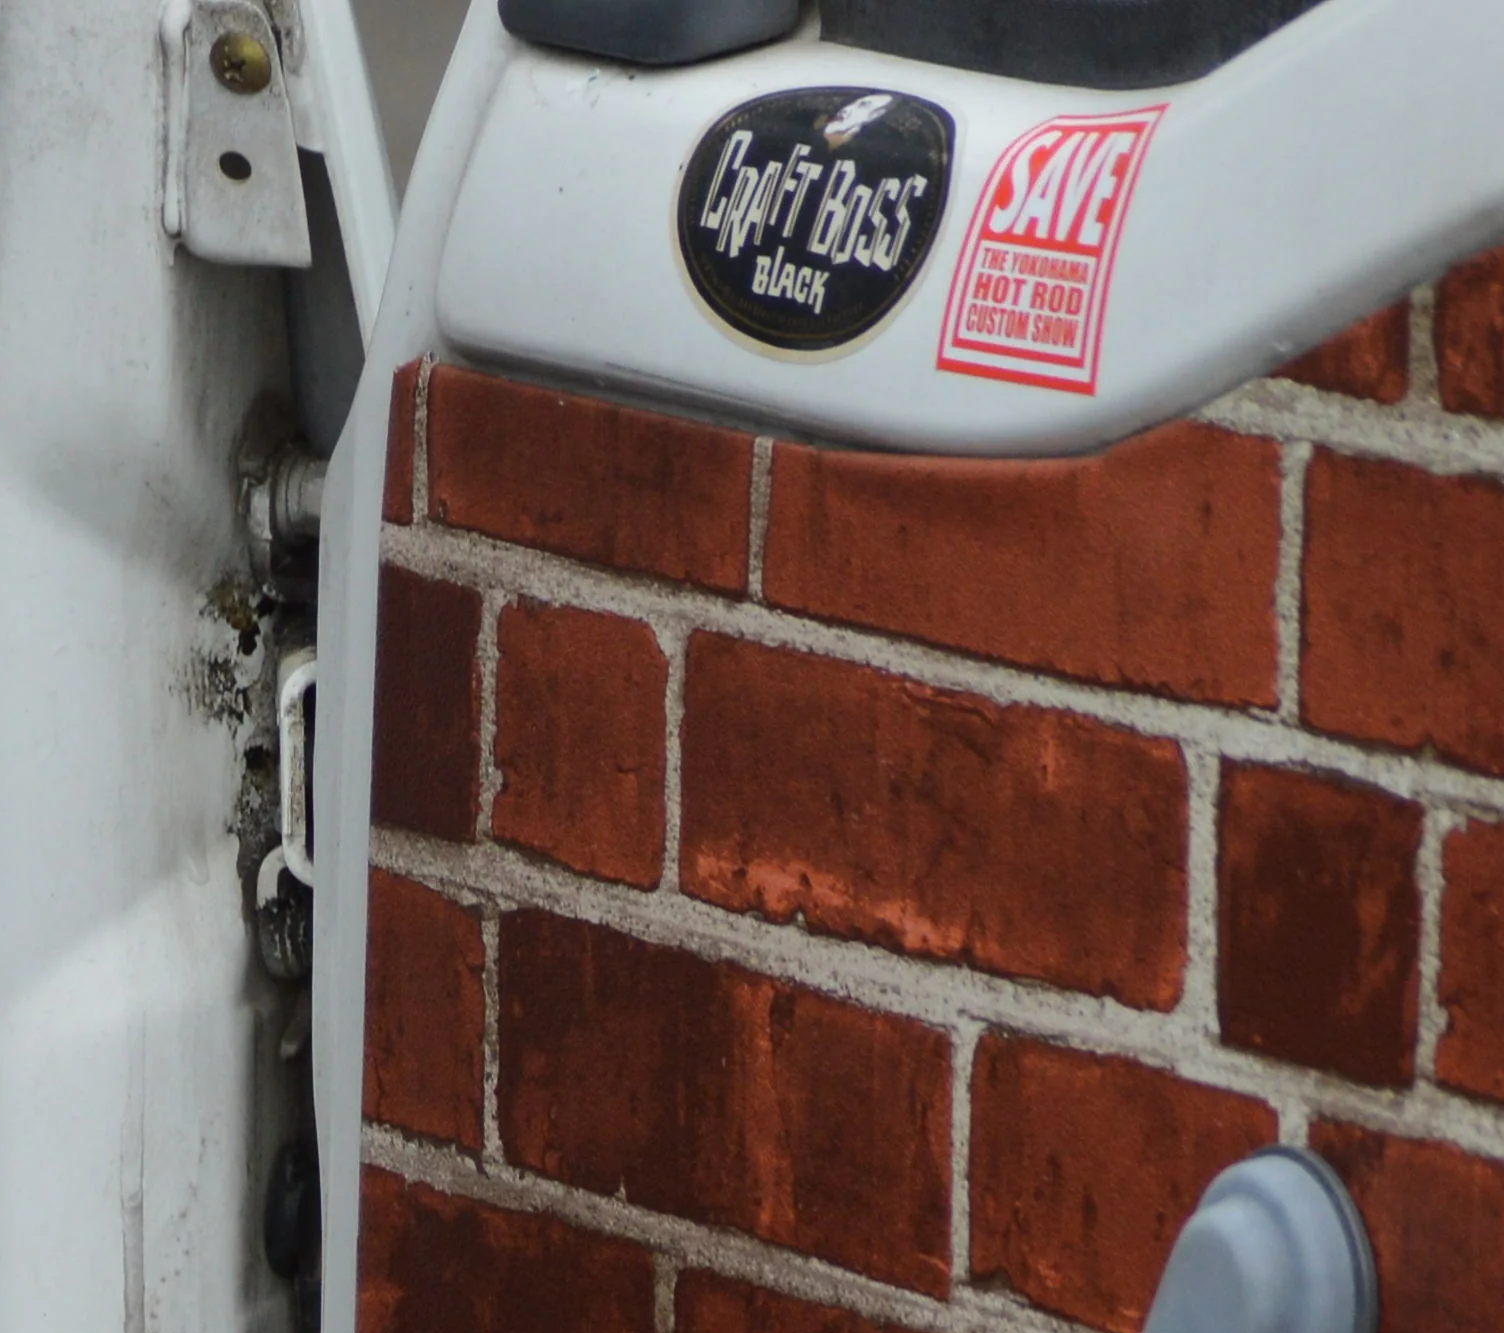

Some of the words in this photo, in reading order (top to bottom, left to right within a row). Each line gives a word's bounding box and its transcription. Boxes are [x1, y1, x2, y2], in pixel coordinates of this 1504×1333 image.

[700, 129, 820, 258] CRAFT
[809, 158, 928, 272] BOSS
[989, 129, 1137, 247] SAVE
[981, 247, 1009, 272] THE
[1011, 252, 1089, 284] YOKOHAMA
[973, 272, 1027, 306] HOT
[1029, 279, 1084, 316] ROD
[966, 303, 1031, 341] CUSTOM
[1031, 312, 1079, 348] SHOW
